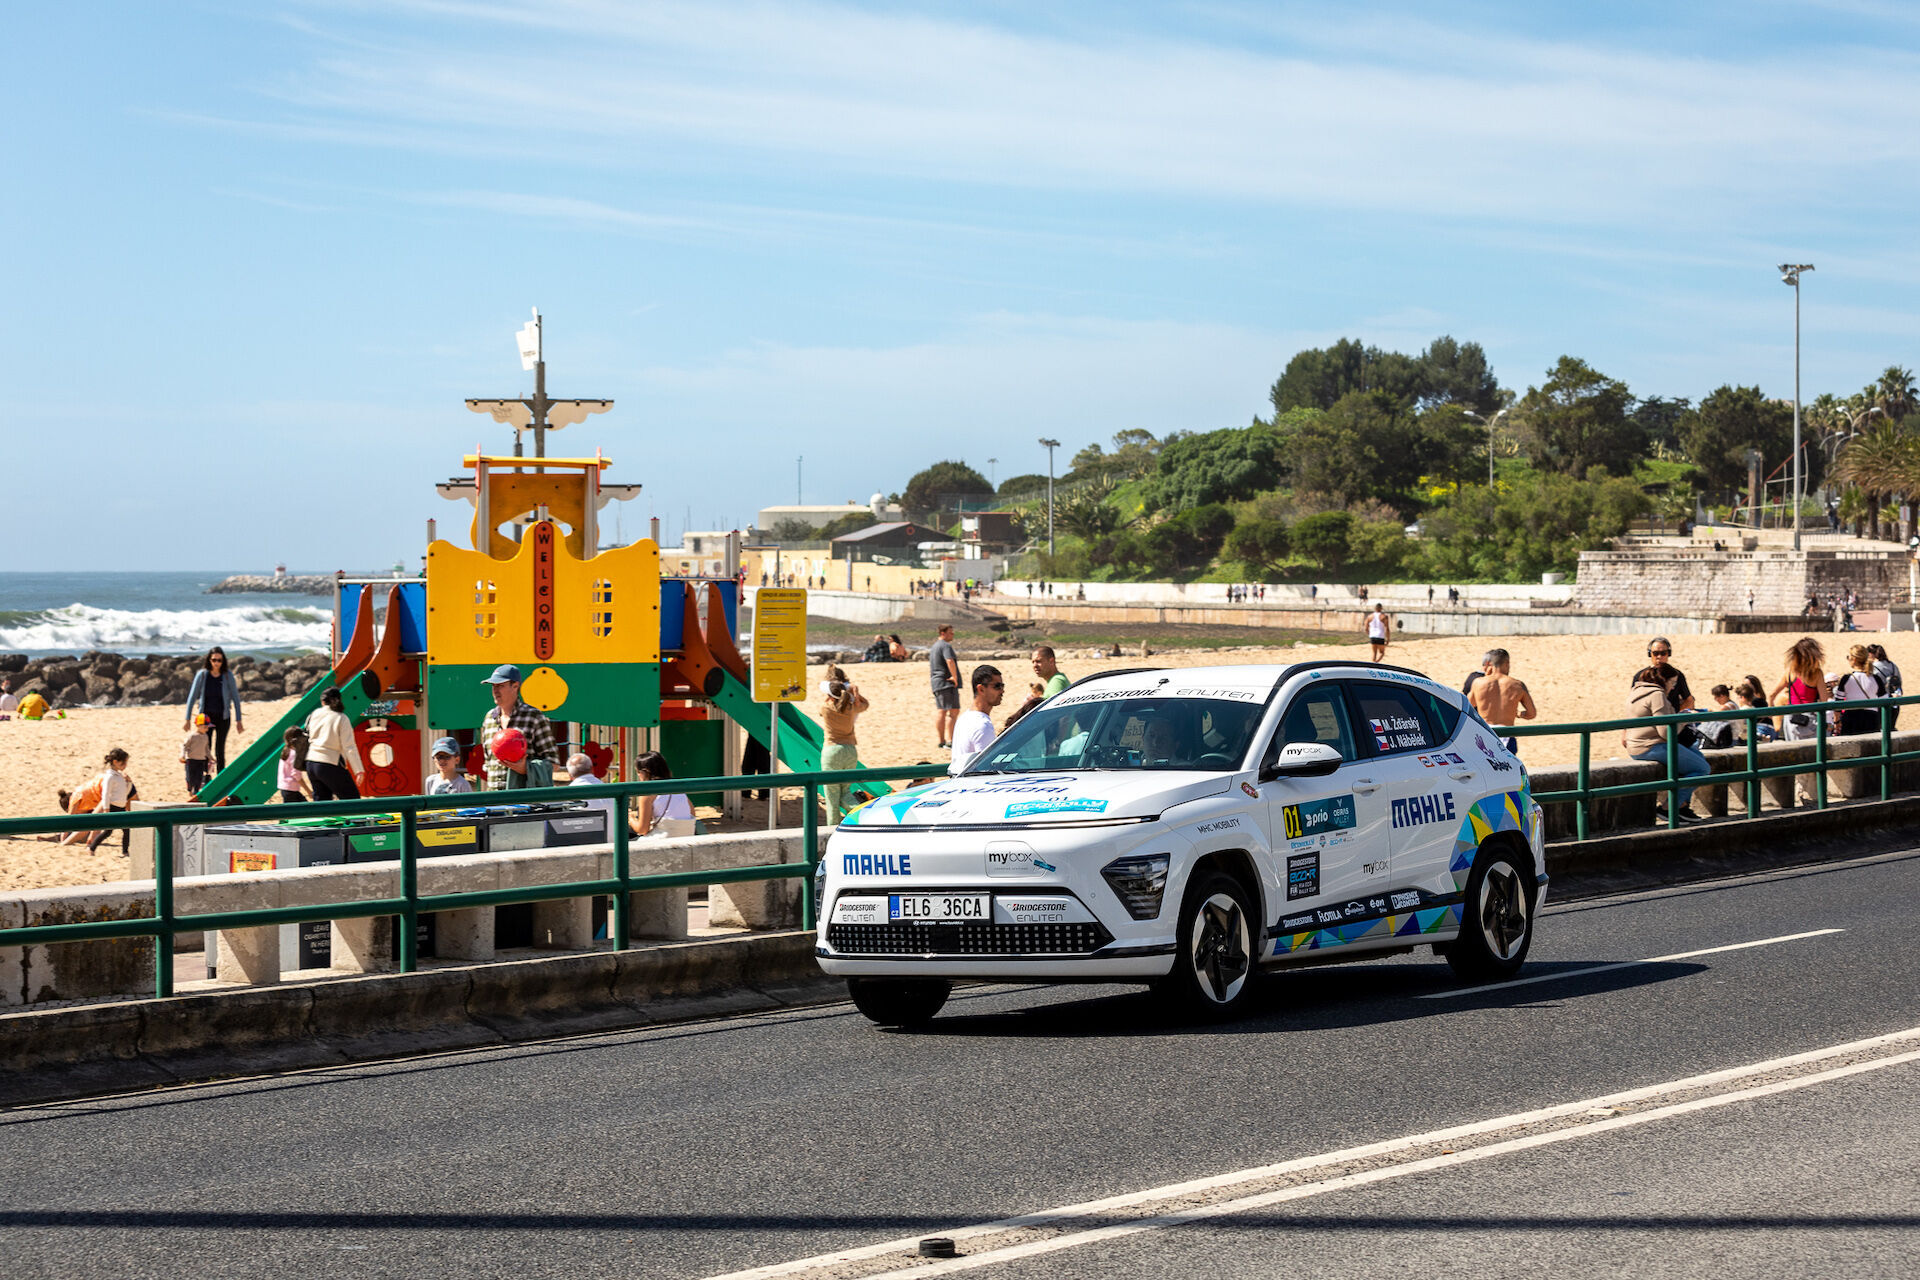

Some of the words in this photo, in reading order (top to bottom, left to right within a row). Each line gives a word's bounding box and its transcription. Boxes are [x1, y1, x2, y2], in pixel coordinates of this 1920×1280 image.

[538, 533, 551, 649] WELCOME
[1053, 688, 1161, 706] BRIDGESTONE
[1176, 688, 1255, 700] ENLITEN
[933, 786, 1069, 796] HYUNDAI
[1312, 808, 1328, 827] prio
[1392, 792, 1455, 828] MAHLE
[1196, 824, 1213, 835] MHC
[1213, 818, 1241, 832] MOBILITY
[1283, 806, 1302, 839] 01
[843, 854, 912, 875] MAHLE
[839, 903, 878, 912] BRIDGESTONE
[903, 898, 931, 917] EL6
[943, 897, 982, 917] 36CA
[1012, 903, 1067, 912] BRIDGESTONE
[842, 914, 875, 922] ENLITEN
[1016, 914, 1063, 922] ENLITEN
